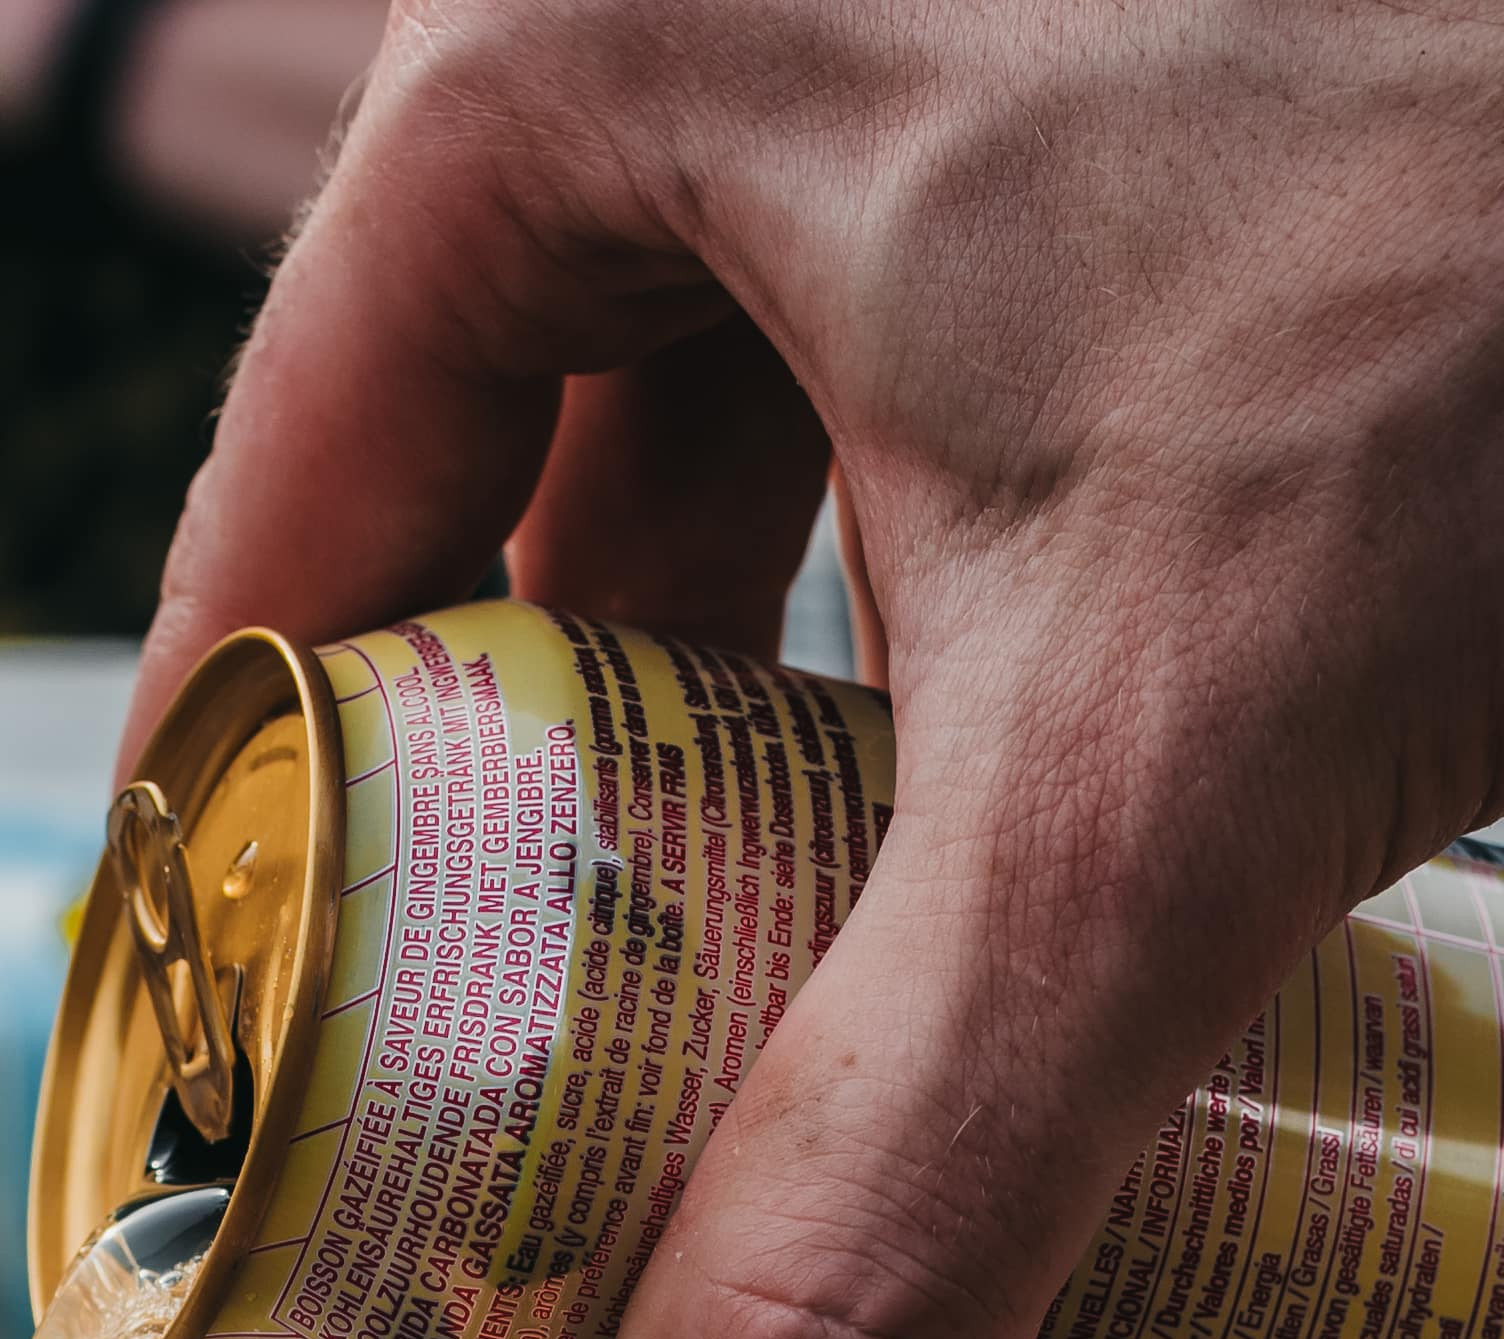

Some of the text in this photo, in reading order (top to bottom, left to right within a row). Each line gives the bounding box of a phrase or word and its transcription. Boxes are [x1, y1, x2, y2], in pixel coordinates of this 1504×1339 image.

[397, 663, 431, 728] ALCOOL
[441, 704, 468, 736] MIT
[411, 726, 434, 782] SANS
[466, 648, 506, 856] GEMBERBIERSMAAK.
[550, 714, 574, 837] ZENZERO.
[627, 735, 651, 821] Conserver
[656, 740, 686, 797] FRAIS
[515, 745, 542, 876] JENGIBRE.
[595, 754, 619, 851] stabilisants
[660, 799, 686, 873] SERVIR
[405, 780, 440, 922] GINGEMBRE
[422, 733, 471, 1038] ERFRISCHUNGSGETRÄNK
[546, 839, 578, 913] ALLO
[621, 824, 655, 937] gingembre).
[660, 875, 687, 894] A
[769, 840, 795, 889] siehe
[477, 861, 508, 916] MET
[512, 877, 542, 900] A
[586, 854, 624, 935] citrique),
[654, 897, 683, 952] boîte.
[692, 829, 724, 980] Säuerungsmittel
[767, 890, 795, 947] Ende:
[806, 870, 839, 967] edingszuur
[401, 926, 431, 963] DE
[498, 905, 538, 1007] SABOR
[576, 937, 610, 1002] (acide
[620, 934, 646, 966] de
[653, 952, 680, 974] la
[726, 872, 758, 1007] (einschließlich
[766, 950, 791, 980] bis
[379, 966, 425, 1072] SAVEUR
[449, 919, 502, 1081] FRISDRANK
[611, 968, 641, 1032] racine
[648, 977, 676, 1005] de
[682, 984, 720, 1059] Zucker,
[484, 1012, 522, 1078] CON
[504, 916, 571, 1146] AROMATIZZATA
[566, 1004, 600, 1063] acide
[602, 1035, 632, 1065] de
[641, 1007, 673, 1055] fond
[712, 1010, 748, 1093] Aromen
[366, 1074, 402, 1098] À
[558, 1066, 593, 1130] sucre,
[632, 1056, 664, 1098] voir
[663, 1064, 708, 1147] Wasser,
[624, 1100, 655, 1133] fin:
[1350, 1084, 1384, 1191] Fettsäuren
[1391, 1139, 1416, 1161] di
[1397, 1106, 1418, 1138] cui
[332, 1100, 397, 1230] GAZÉIFIÉE
[418, 1082, 507, 1293] CARBONATADA
[529, 1133, 576, 1232] gazéifiée,
[568, 1143, 609, 1224] compris
[617, 1135, 646, 1195] avant
[1307, 1128, 1341, 1197] Grassi
[460, 1146, 526, 1280] GASSATA
[552, 1227, 587, 1249] (y
[1155, 1135, 1224, 1329] Durchschnittliche
[1206, 1073, 1229, 1133] werte
[1193, 1239, 1238, 1323] Valores
[1222, 1153, 1255, 1236] medios
[1240, 1112, 1262, 1153] por
[1378, 1174, 1412, 1277] saturadas
[287, 1229, 353, 1330] BOISSON
[506, 1232, 542, 1273] Eau
[576, 1197, 628, 1299] préférence
[1288, 1211, 1329, 1288] Grasas
[1335, 1194, 1371, 1297] gesättigte
[529, 1250, 574, 1319] arômes
[562, 1300, 588, 1325] de
[1236, 1249, 1284, 1331] Energia
